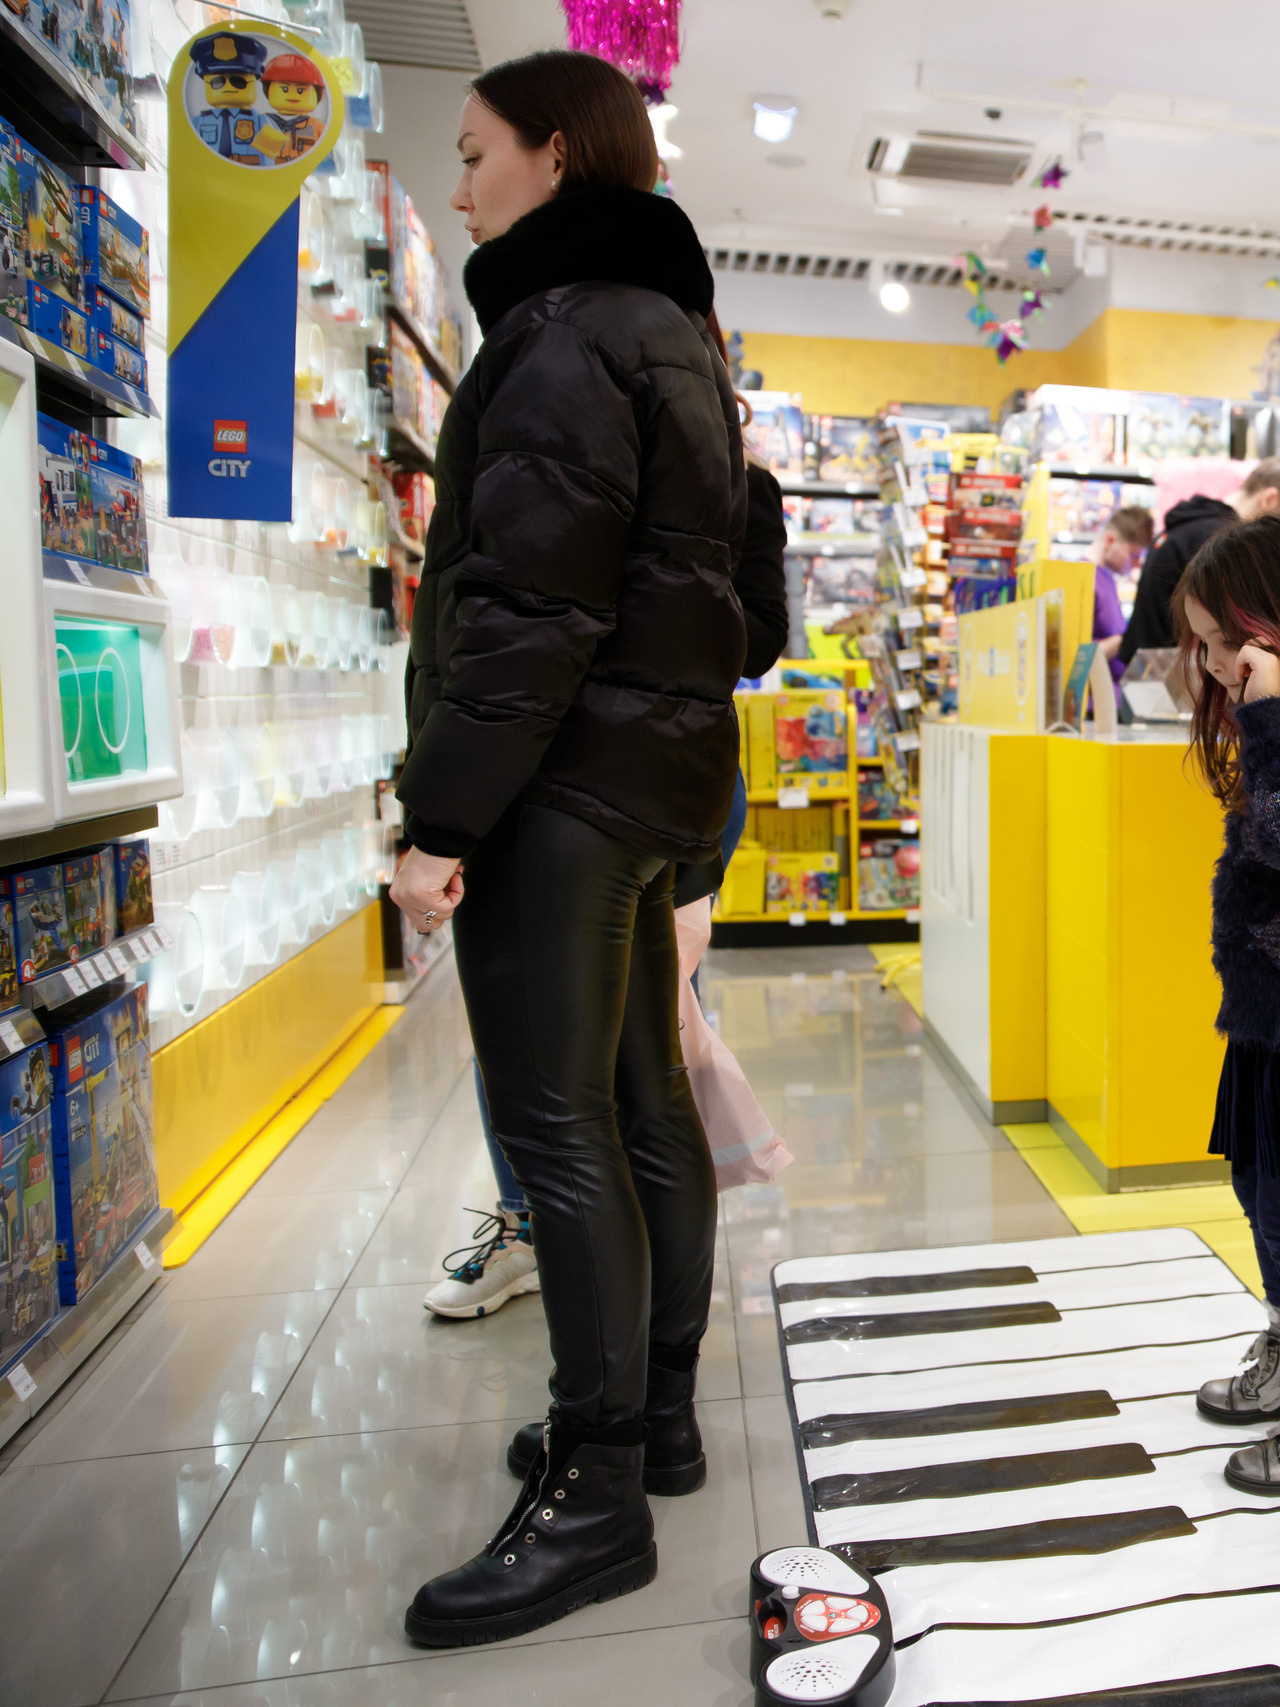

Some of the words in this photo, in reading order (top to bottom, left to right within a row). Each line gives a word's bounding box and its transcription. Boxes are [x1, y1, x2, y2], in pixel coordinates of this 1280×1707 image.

[216, 429, 245, 442] LEGO
[207, 458, 252, 478] CITY
[70, 1100, 79, 1117] 6+
